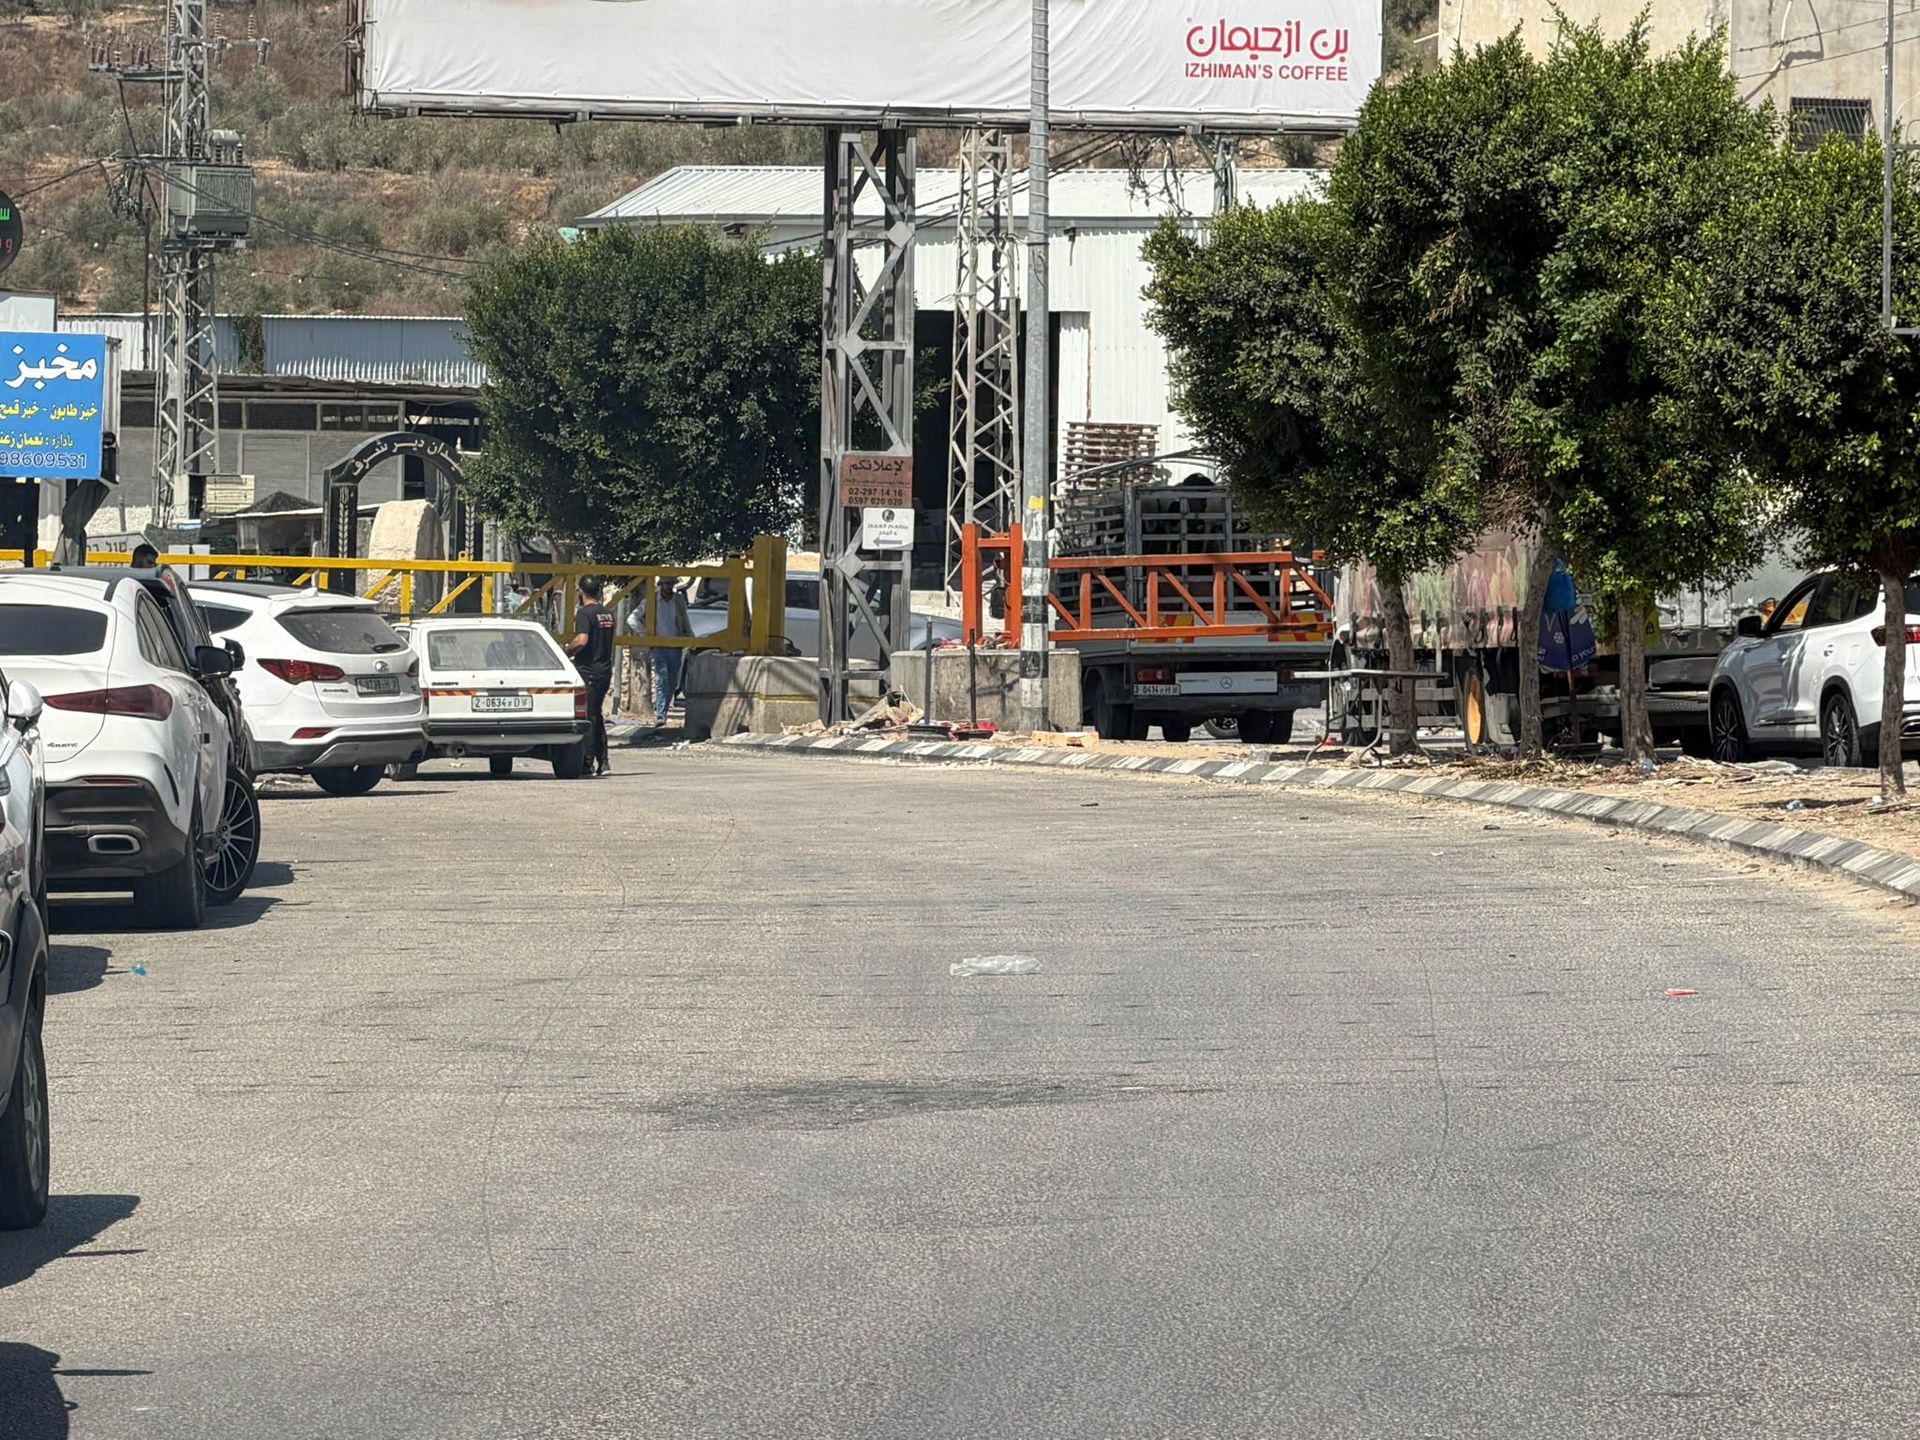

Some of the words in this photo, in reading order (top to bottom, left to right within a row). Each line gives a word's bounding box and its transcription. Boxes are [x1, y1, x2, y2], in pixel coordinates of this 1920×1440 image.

[1186, 18, 1301, 61] ازحيمان
[1310, 28, 1349, 61] بن
[1185, 62, 1273, 79] IZHIMAN'S
[1278, 65, 1348, 82] COFFEE
[4, 343, 98, 390] مخبز
[20, 401, 40, 419] خبز
[50, 402, 78, 420] طابون
[79, 402, 98, 420] خبز
[391, 439, 425, 453] دير
